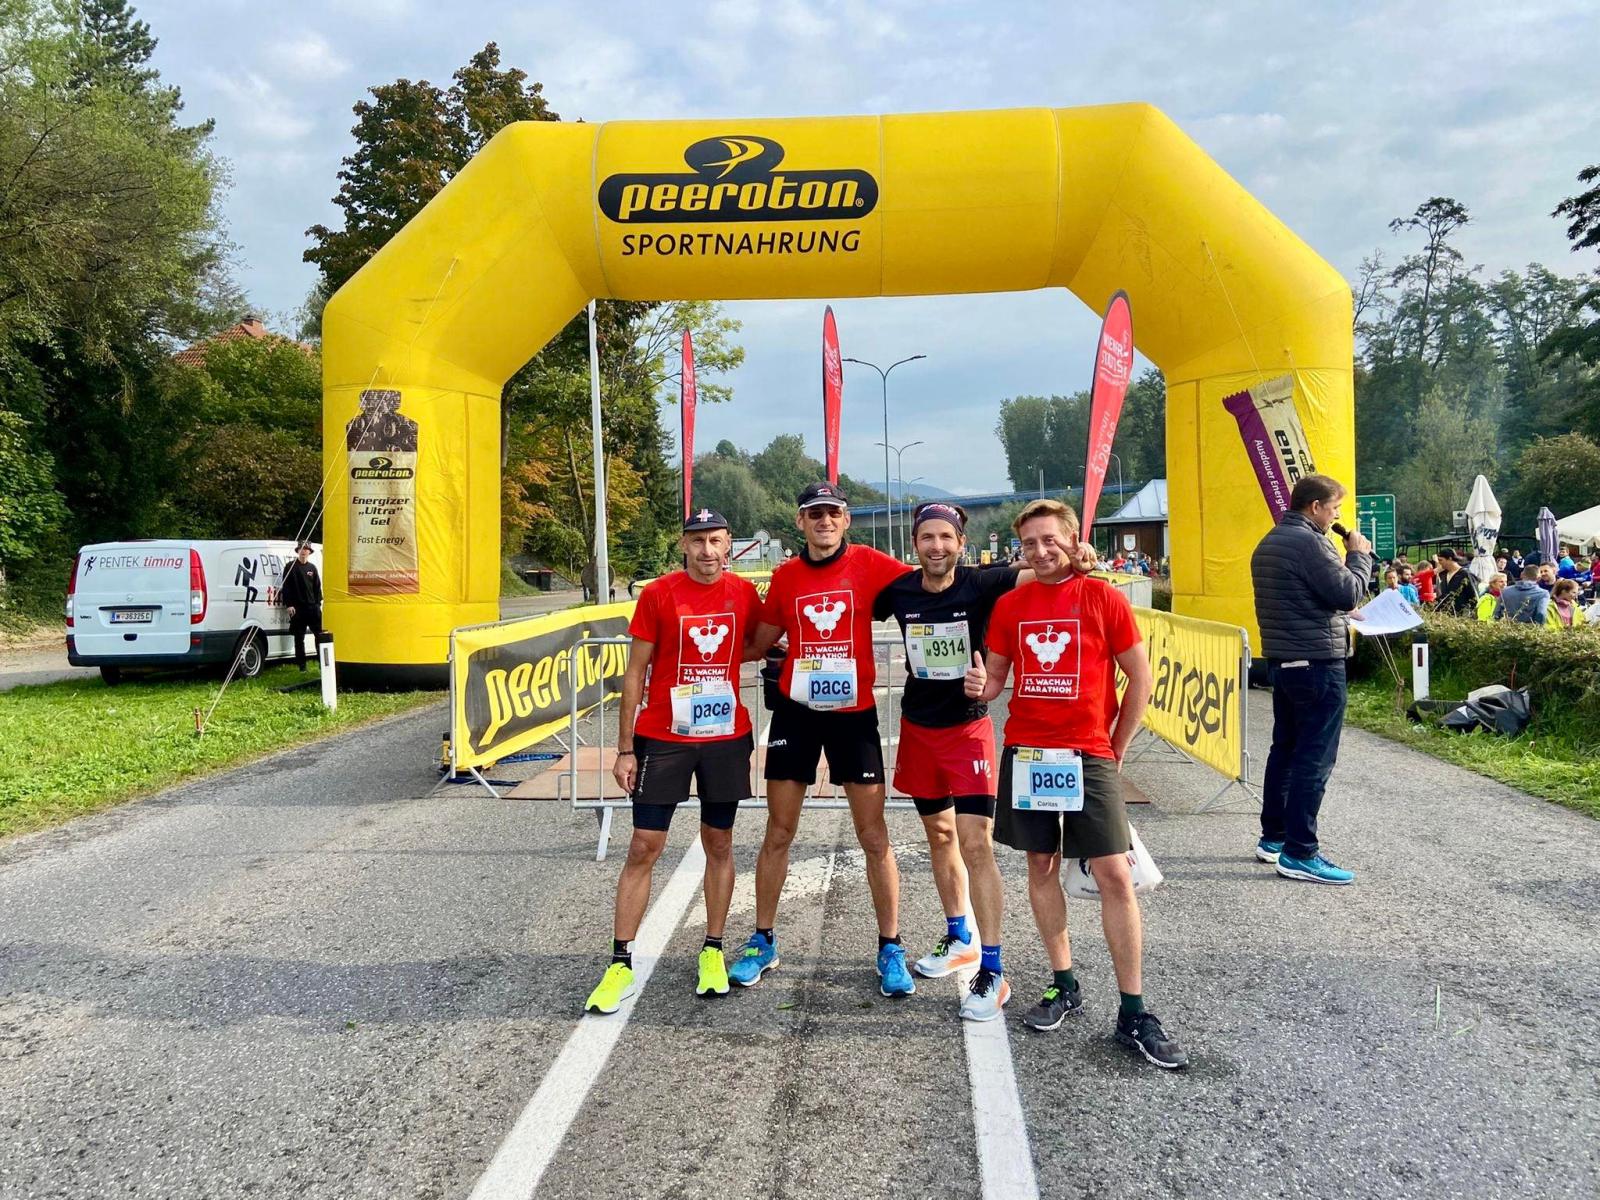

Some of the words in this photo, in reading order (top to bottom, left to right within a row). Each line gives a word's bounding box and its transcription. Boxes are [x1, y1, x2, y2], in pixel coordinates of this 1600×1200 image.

[622, 230, 861, 256] SPORTNAHRUNG
[354, 469, 411, 479] peeroton
[1255, 439, 1276, 480] Ausdauer
[1270, 480, 1288, 512] Energie
[352, 496, 410, 507] Energizer
[370, 517, 391, 526] Gel
[357, 535, 374, 544] Fast
[376, 536, 405, 546] Energy
[100, 556, 140, 568] PENTEK
[143, 556, 183, 569] timing
[815, 645, 849, 653] WACHAU
[932, 638, 966, 657] 9314
[683, 675, 724, 683] MARATHON
[811, 679, 851, 699] pace
[1024, 685, 1072, 694] MARATHON
[693, 702, 730, 724] pace
[1032, 771, 1076, 794] pace
